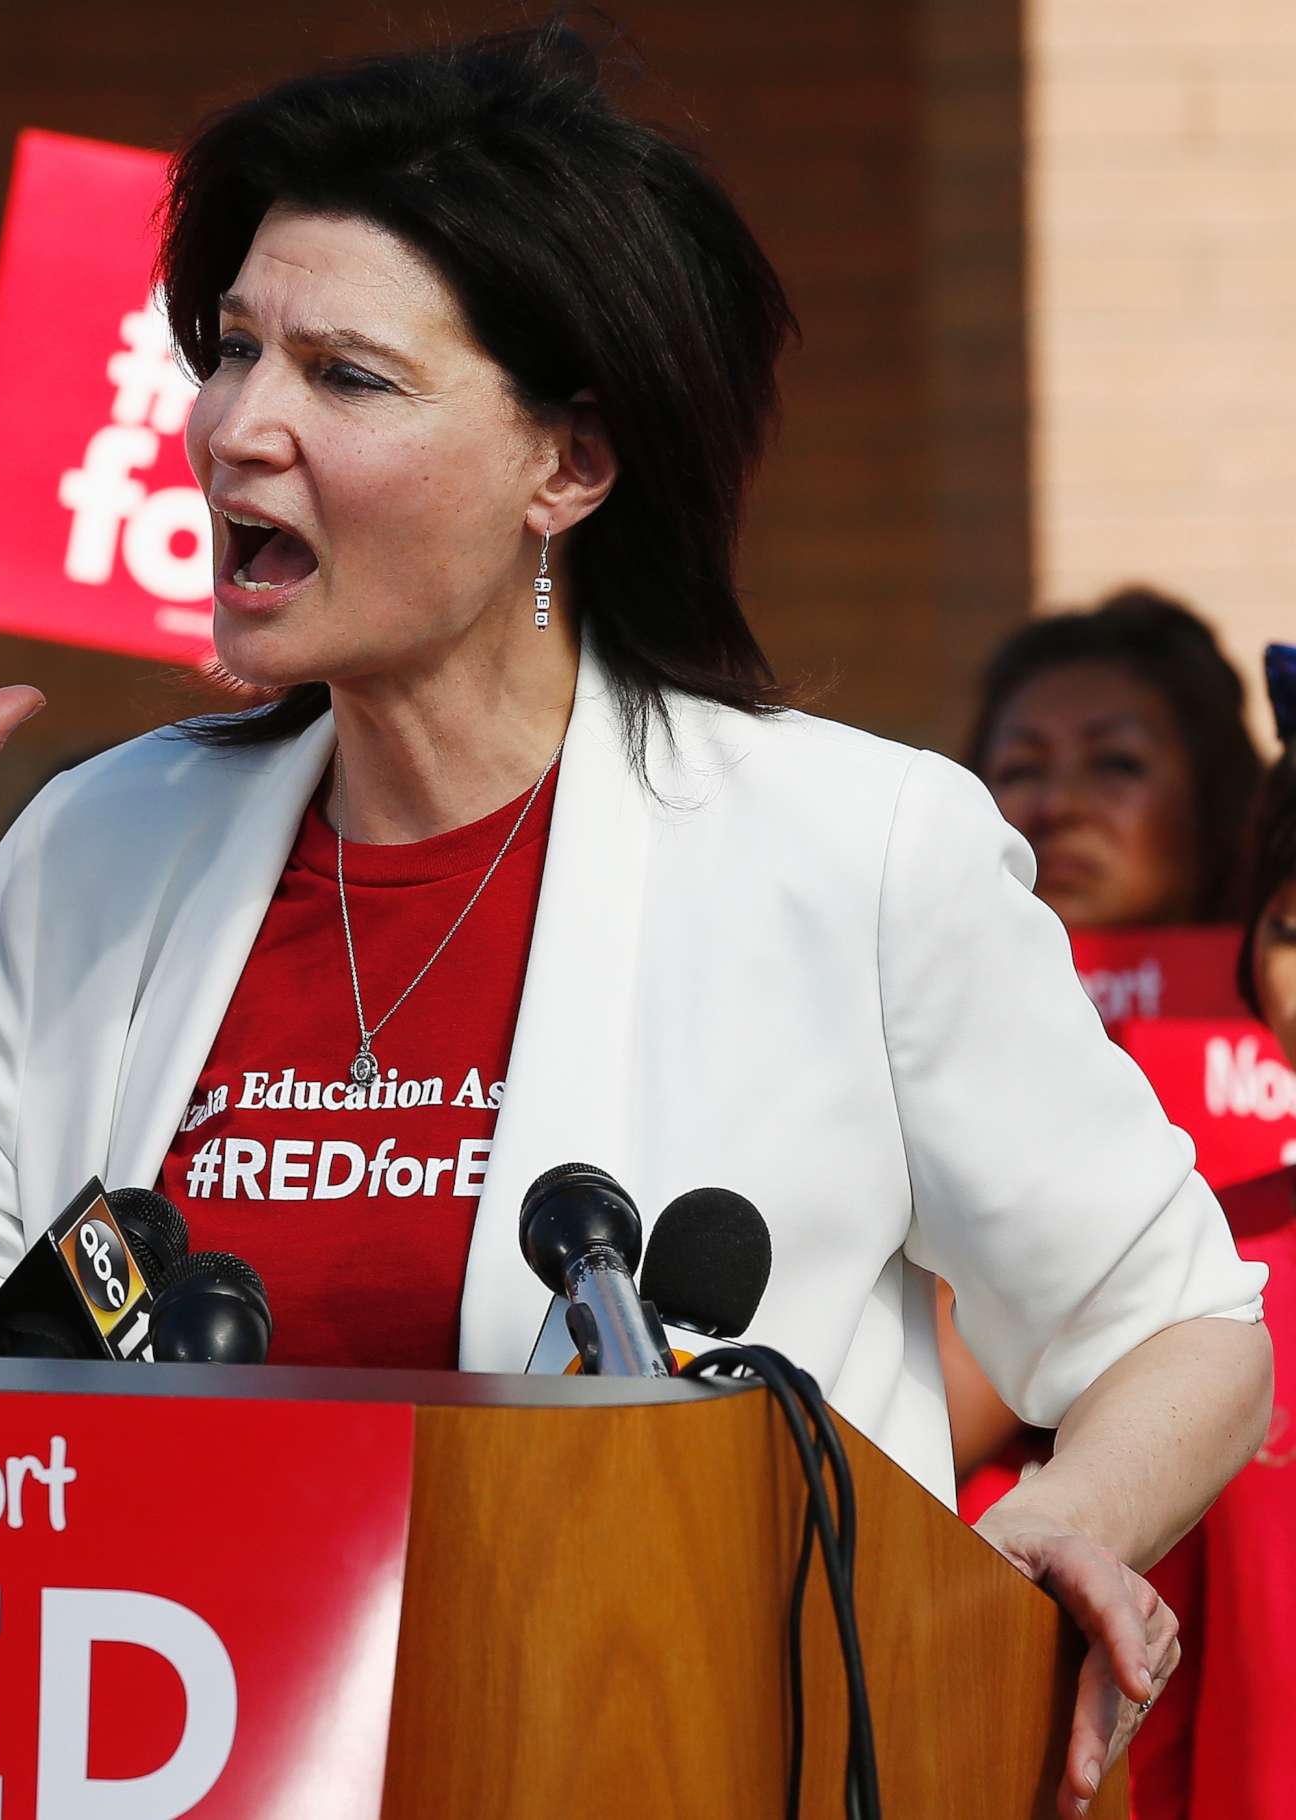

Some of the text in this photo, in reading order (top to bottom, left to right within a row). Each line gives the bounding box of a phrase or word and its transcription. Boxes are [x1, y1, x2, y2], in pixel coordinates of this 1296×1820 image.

[58, 425, 215, 602] fo
[235, 1067, 443, 1110] Education
[450, 1067, 505, 1109] As
[1205, 1035, 1296, 1120] No
[186, 1137, 494, 1200] #REDforE
[79, 1223, 125, 1309] abc
